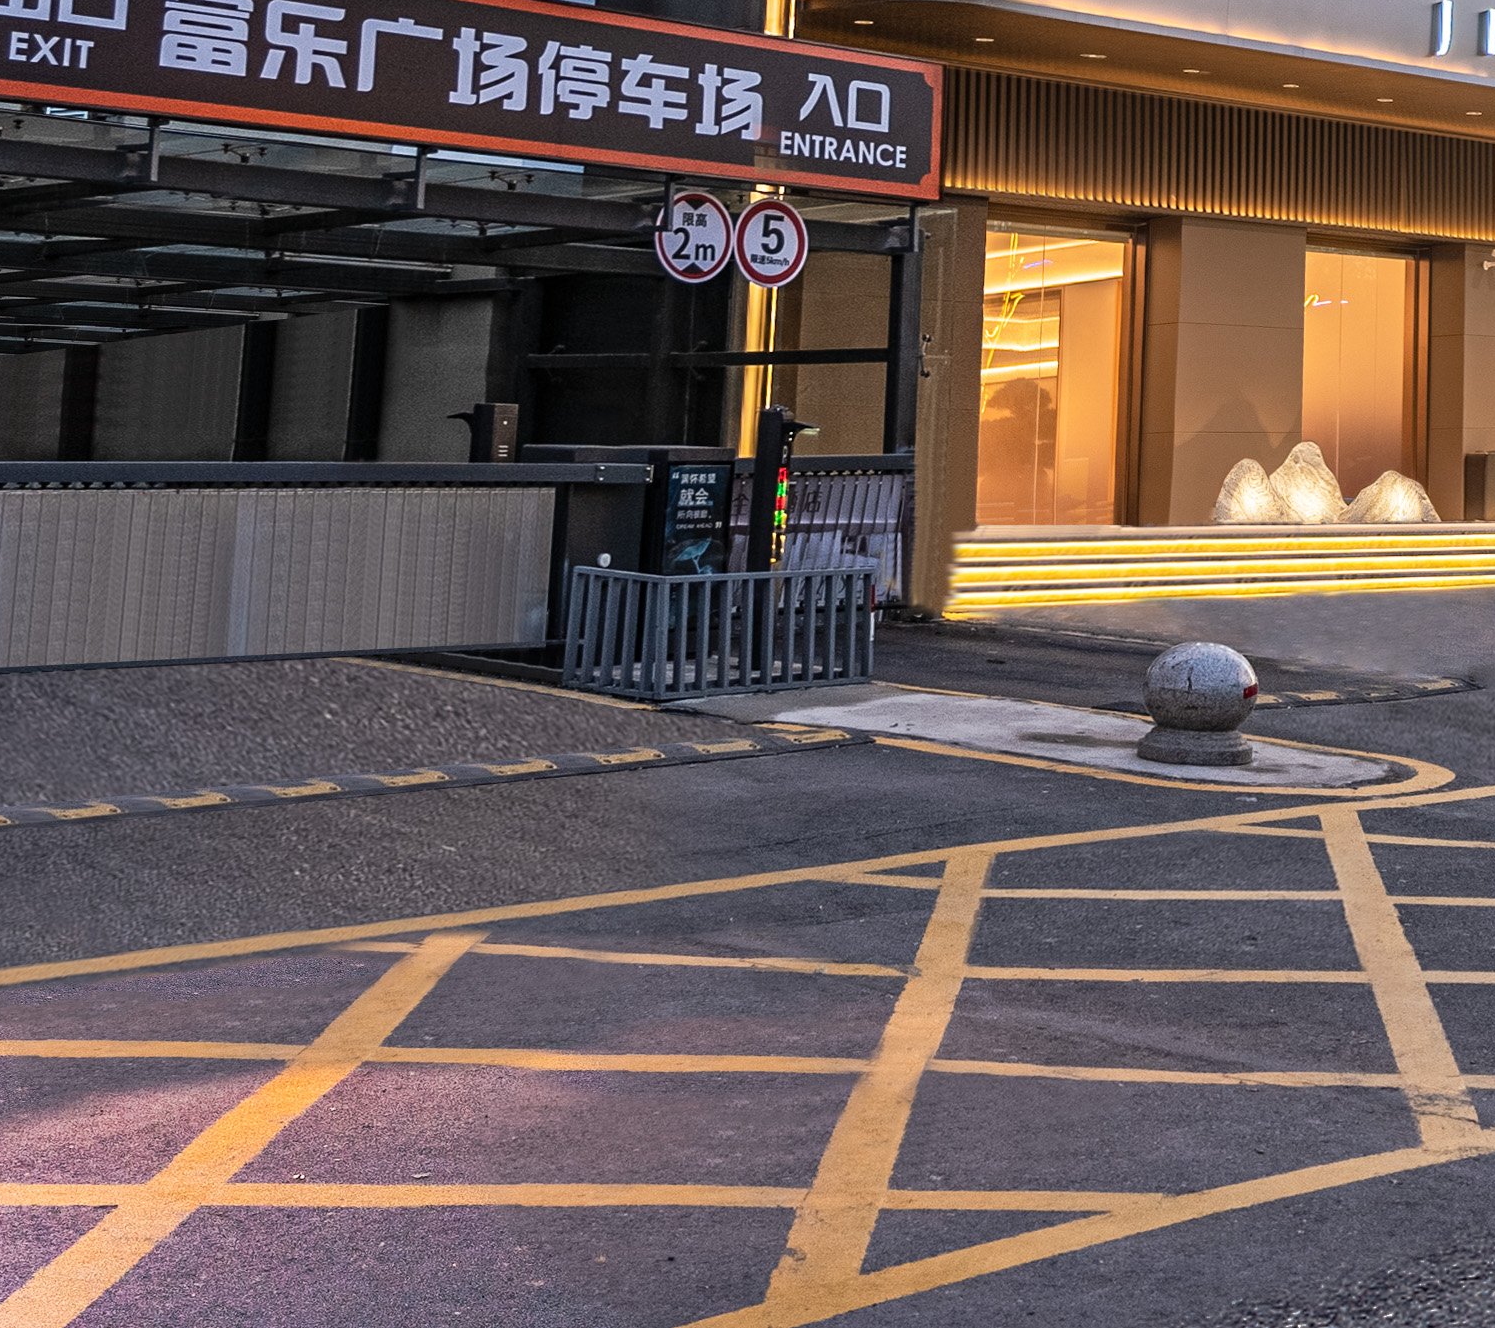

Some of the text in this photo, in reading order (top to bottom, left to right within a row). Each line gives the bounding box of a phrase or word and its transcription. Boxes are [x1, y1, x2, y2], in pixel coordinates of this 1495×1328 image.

[8, 30, 95, 71] EXIT
[798, 71, 892, 134] 入口
[779, 128, 909, 169] ENTRANCE
[682, 212, 708, 228] 限高
[761, 214, 786, 255] 5
